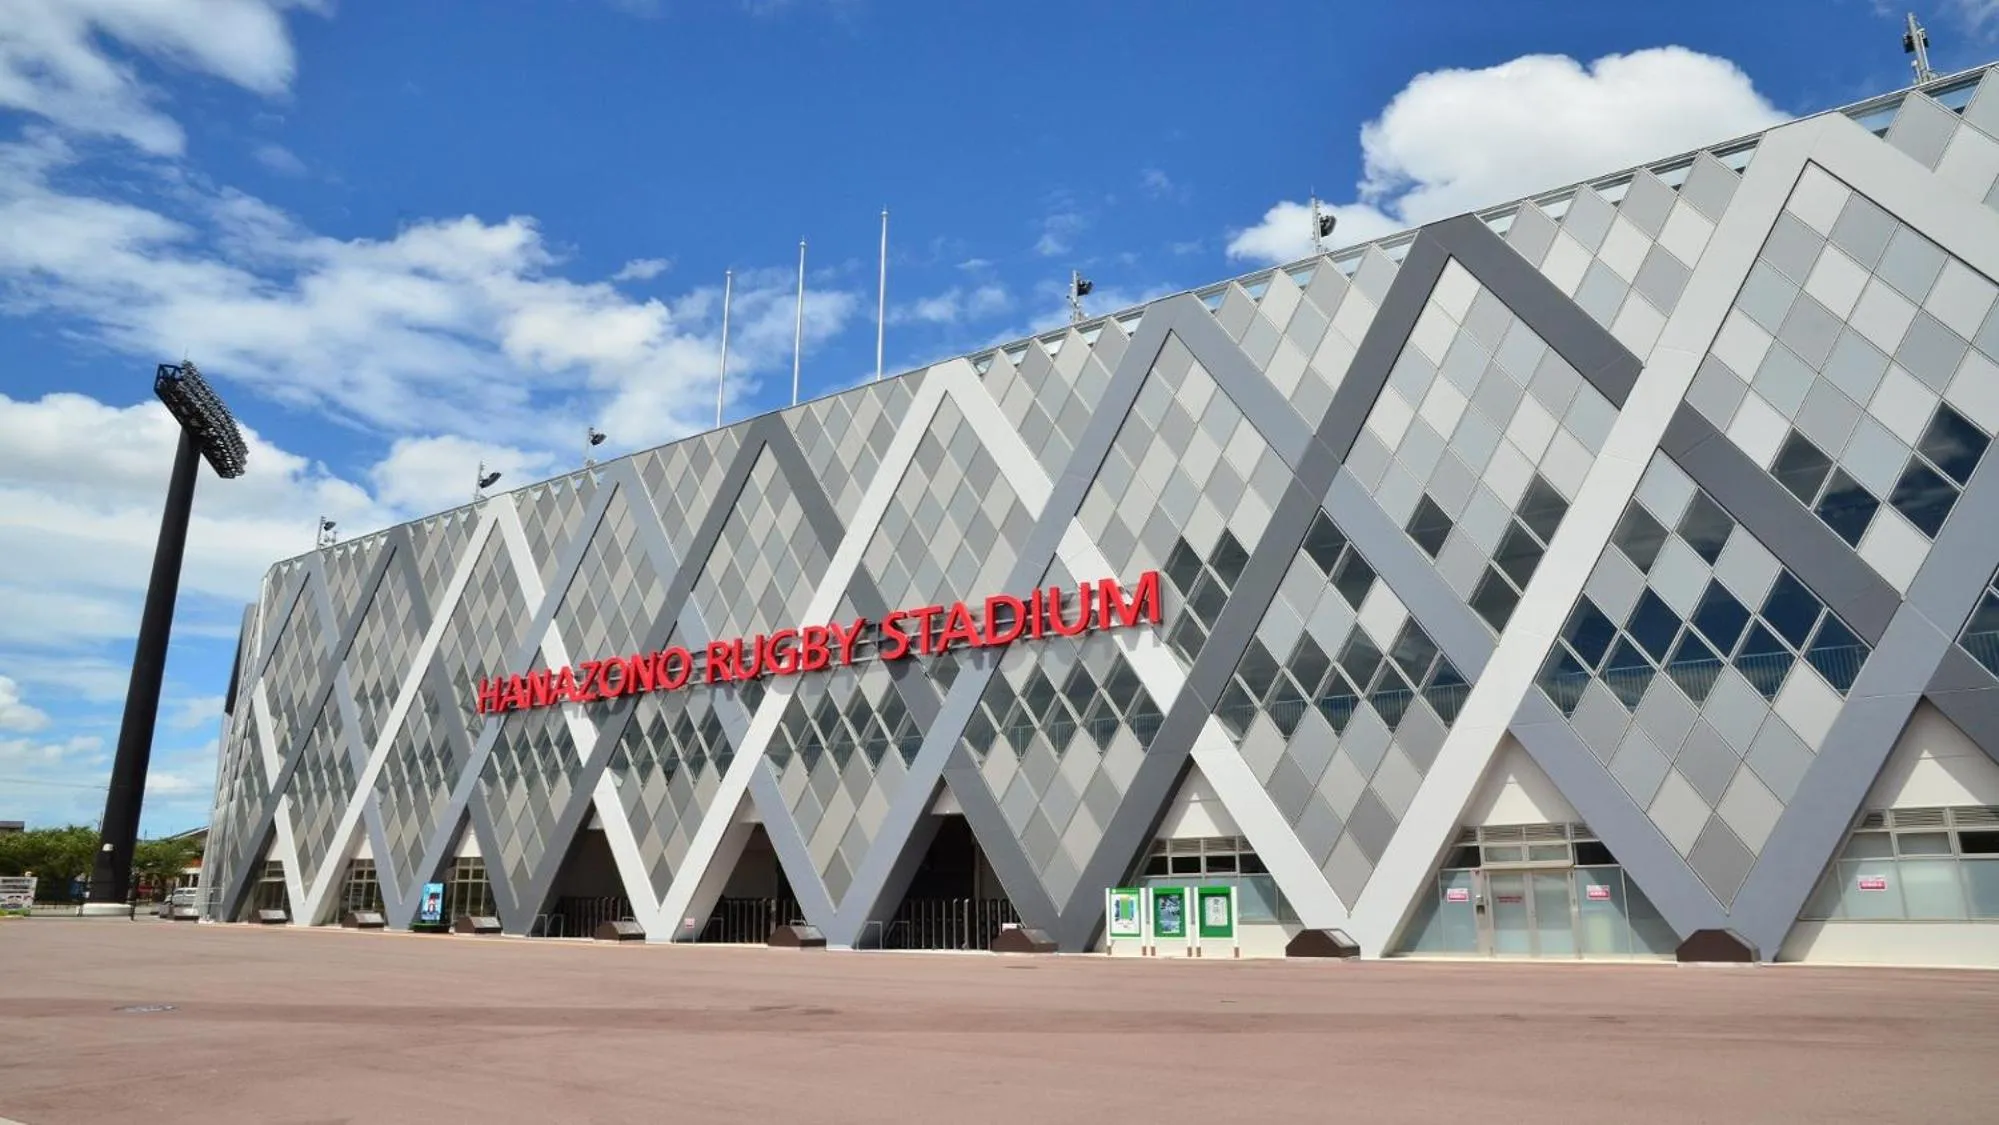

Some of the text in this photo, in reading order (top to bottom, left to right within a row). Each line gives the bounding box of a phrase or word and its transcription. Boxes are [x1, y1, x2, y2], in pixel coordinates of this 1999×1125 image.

[477, 570, 1162, 714] HANAZONO RUGBY STADIUM
